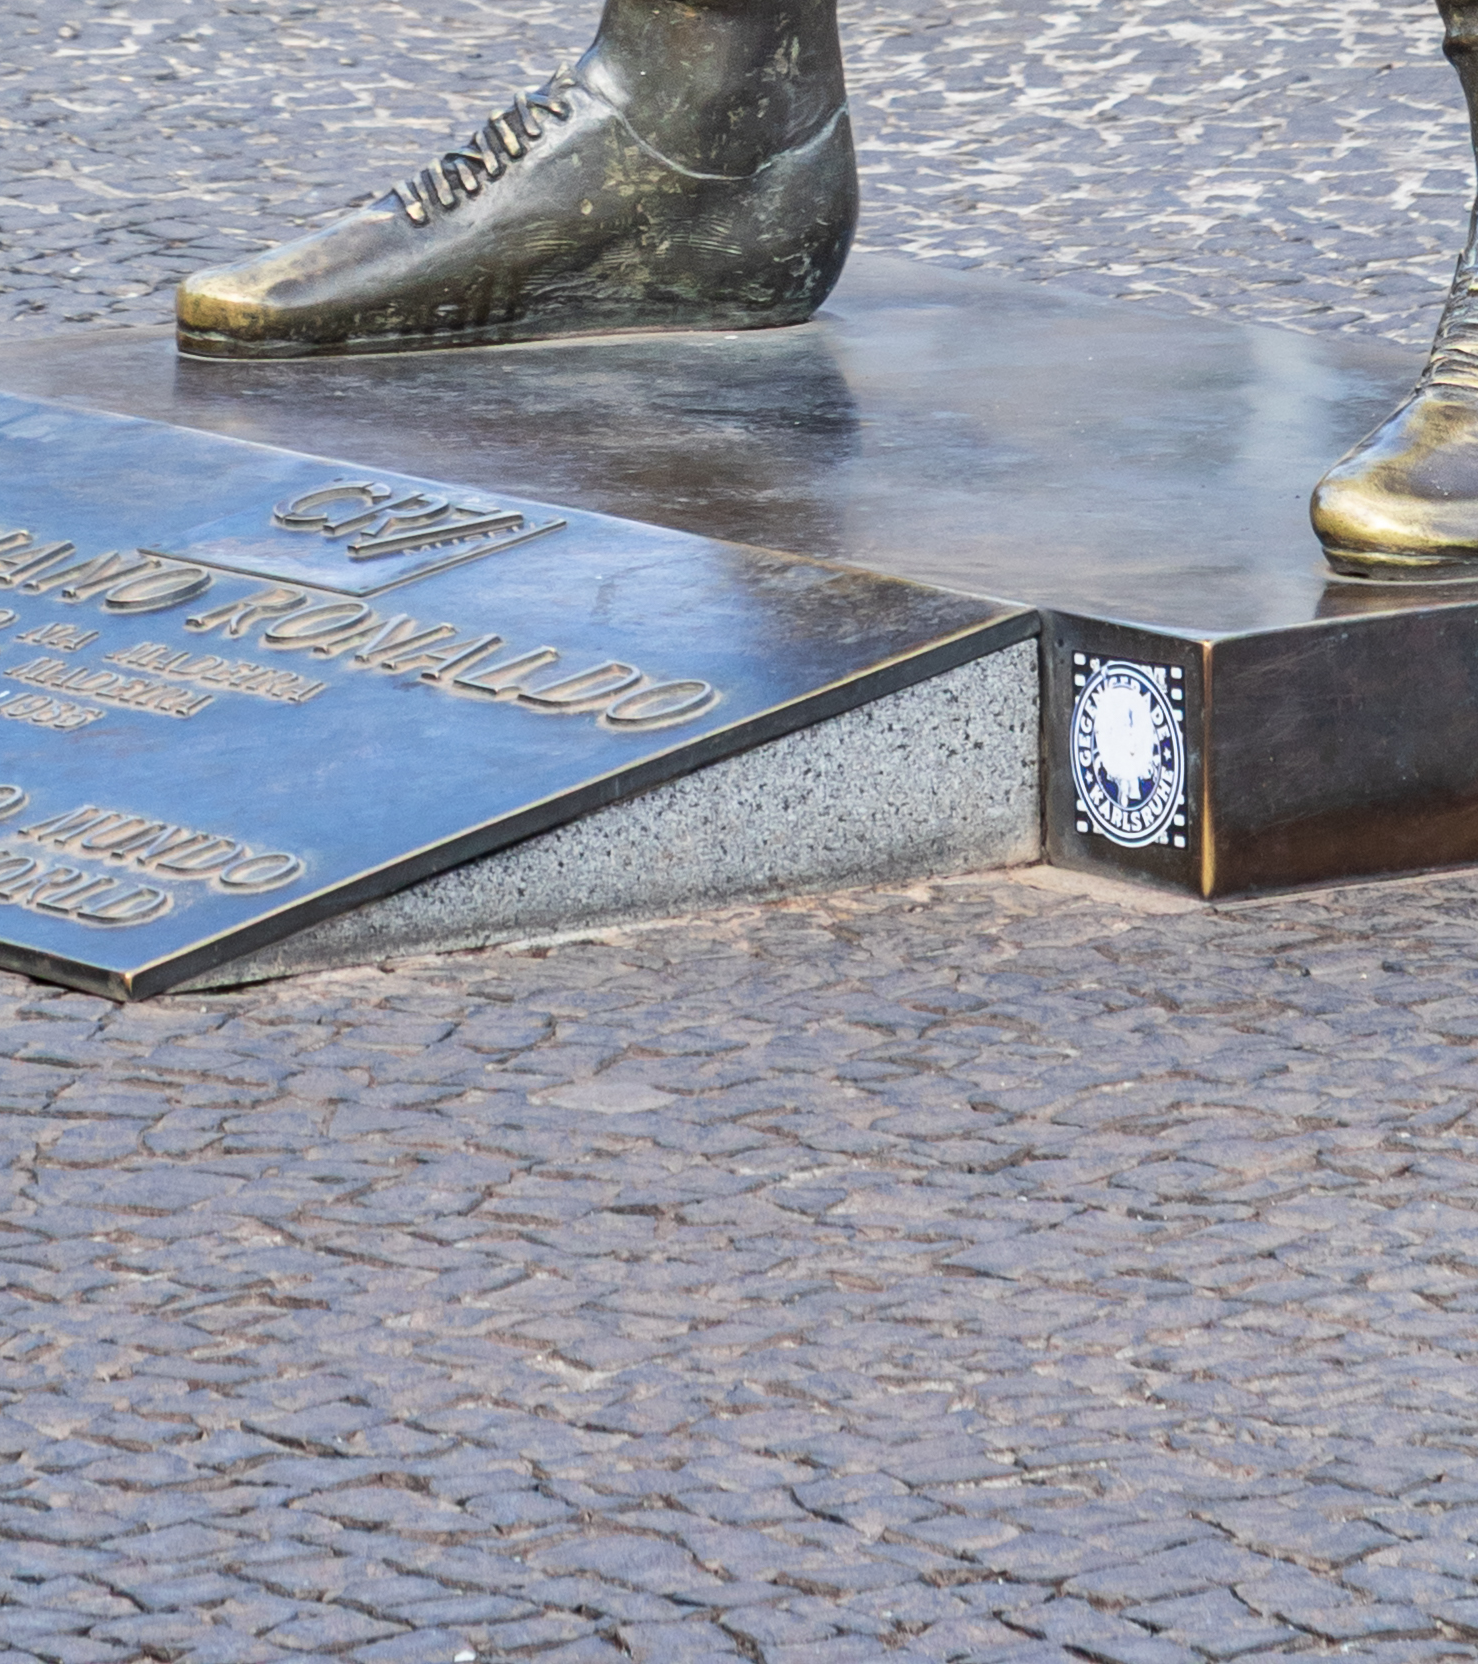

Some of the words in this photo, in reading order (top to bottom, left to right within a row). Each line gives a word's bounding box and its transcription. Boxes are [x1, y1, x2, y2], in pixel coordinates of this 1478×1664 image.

[273, 480, 524, 560] CR7
[4, 657, 213, 716] MADEIRA
[16, 622, 99, 650] NA
[105, 641, 325, 702] MADEIRA
[184, 588, 716, 723] RONALDO
[1089, 765, 1175, 832] KARLSRUHE
[19, 805, 302, 892] MUNDO
